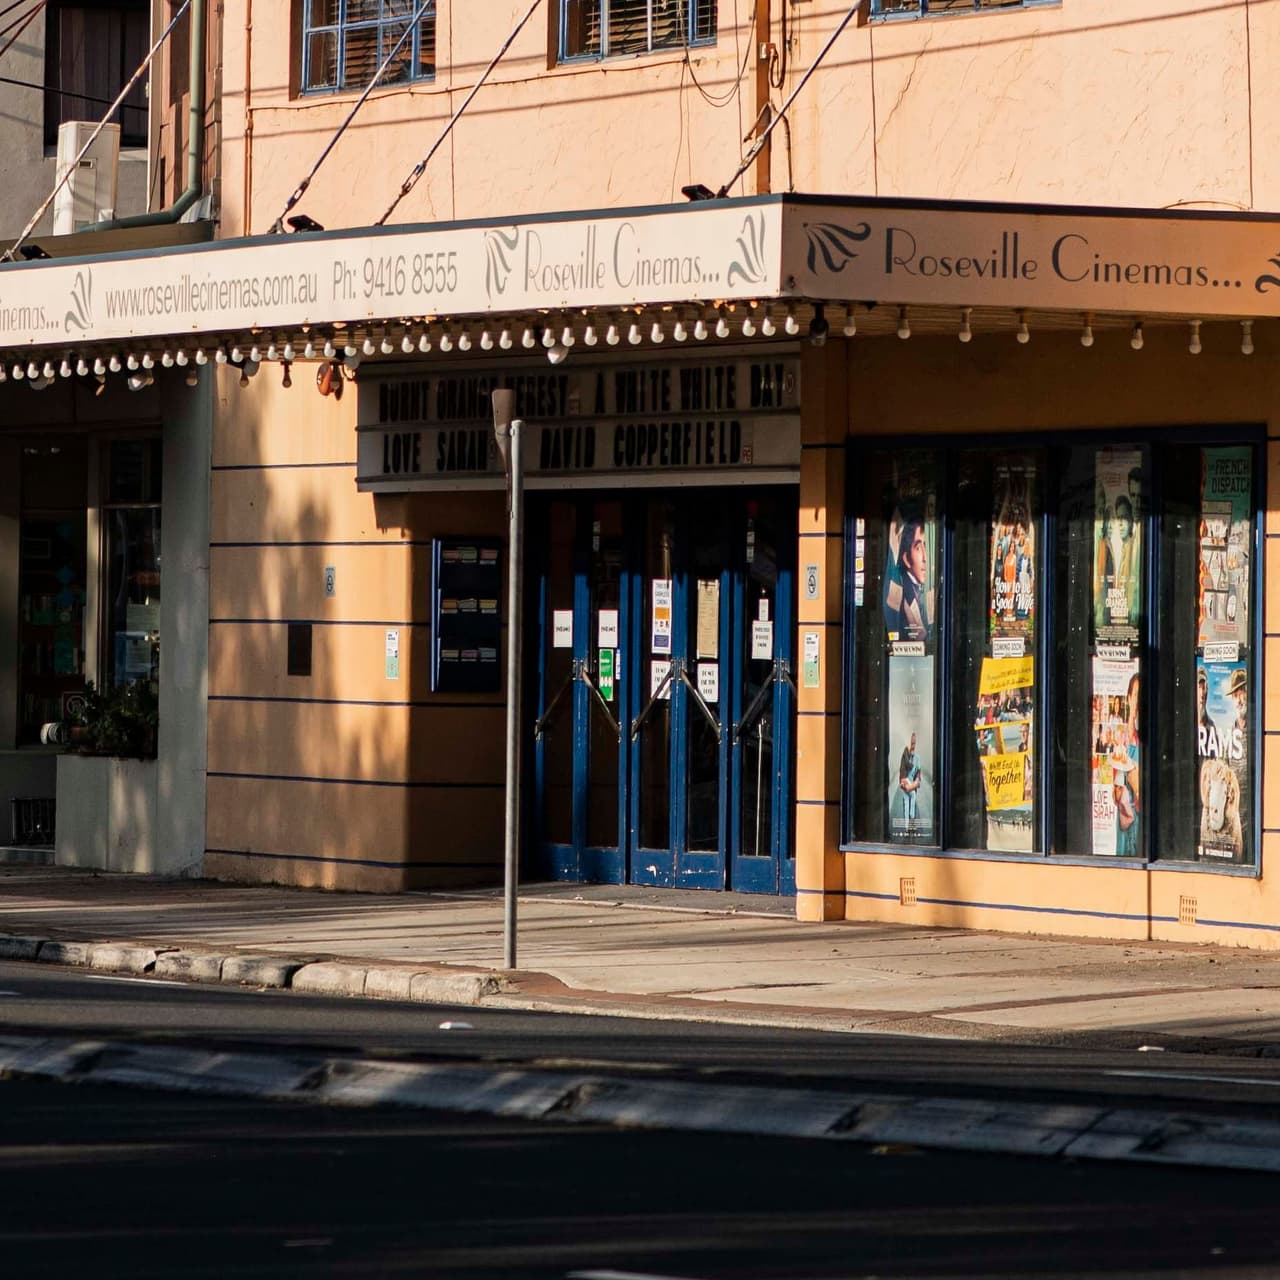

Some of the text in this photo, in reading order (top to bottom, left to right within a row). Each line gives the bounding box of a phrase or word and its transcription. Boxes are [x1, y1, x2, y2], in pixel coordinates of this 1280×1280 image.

[523, 224, 606, 292] Roseville
[884, 227, 1039, 281] Roseville
[106, 251, 458, 319] www.rosevillecinemas.com.au Ph: 9416 8555
[595, 363, 784, 413] A WHITE WHITE DAY
[383, 430, 488, 473] LOVE SARAH
[540, 421, 741, 469] DAVID COPPERFIELD
[1198, 726, 1243, 760] RAMS
[989, 771, 1022, 794] Together
